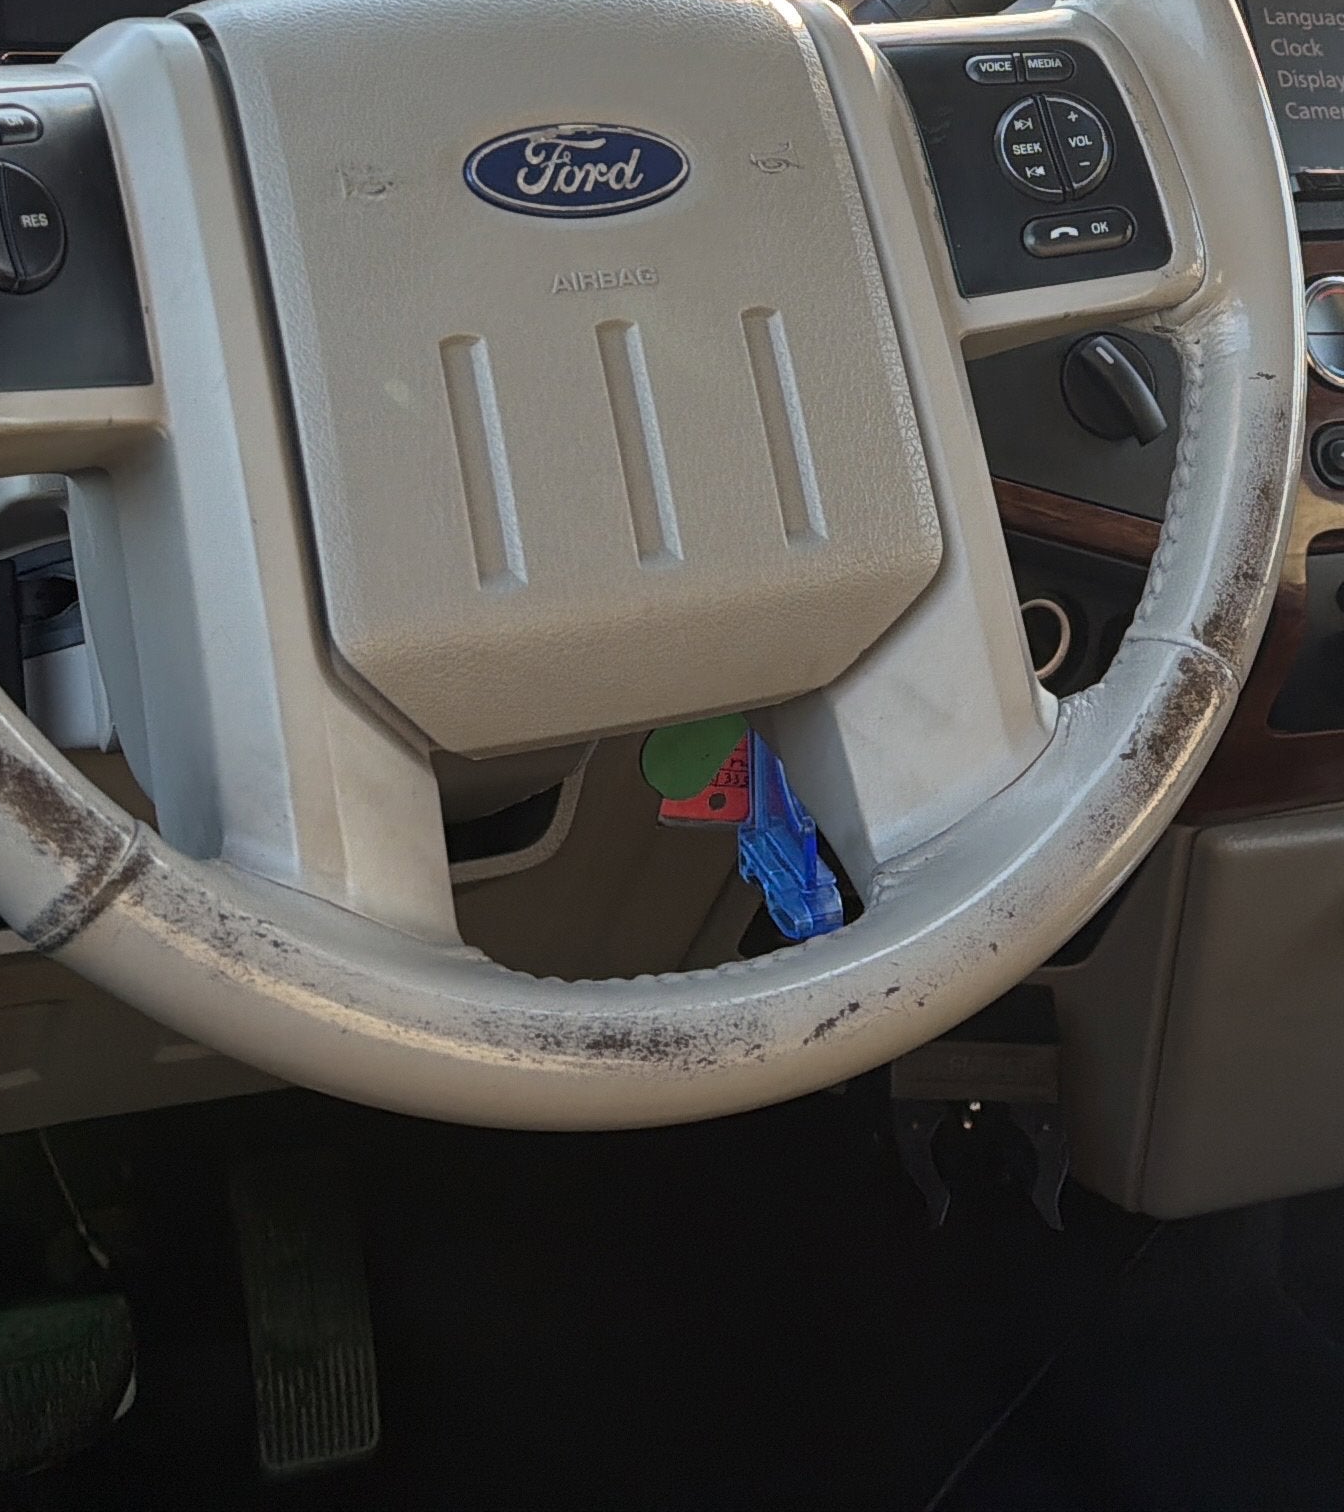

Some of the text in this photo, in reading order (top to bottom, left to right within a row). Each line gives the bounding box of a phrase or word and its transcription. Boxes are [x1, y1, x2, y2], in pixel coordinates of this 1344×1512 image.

[1270, 38, 1323, 57] Clock
[978, 61, 1013, 73] VOICE
[1027, 58, 1063, 69] MEDIA
[1068, 134, 1093, 148] VOL
[1012, 142, 1043, 156] SEEK
[516, 137, 644, 195] Ford
[20, 212, 49, 228] RES
[1091, 221, 1109, 235] OK
[551, 266, 659, 294] AIRBAG
